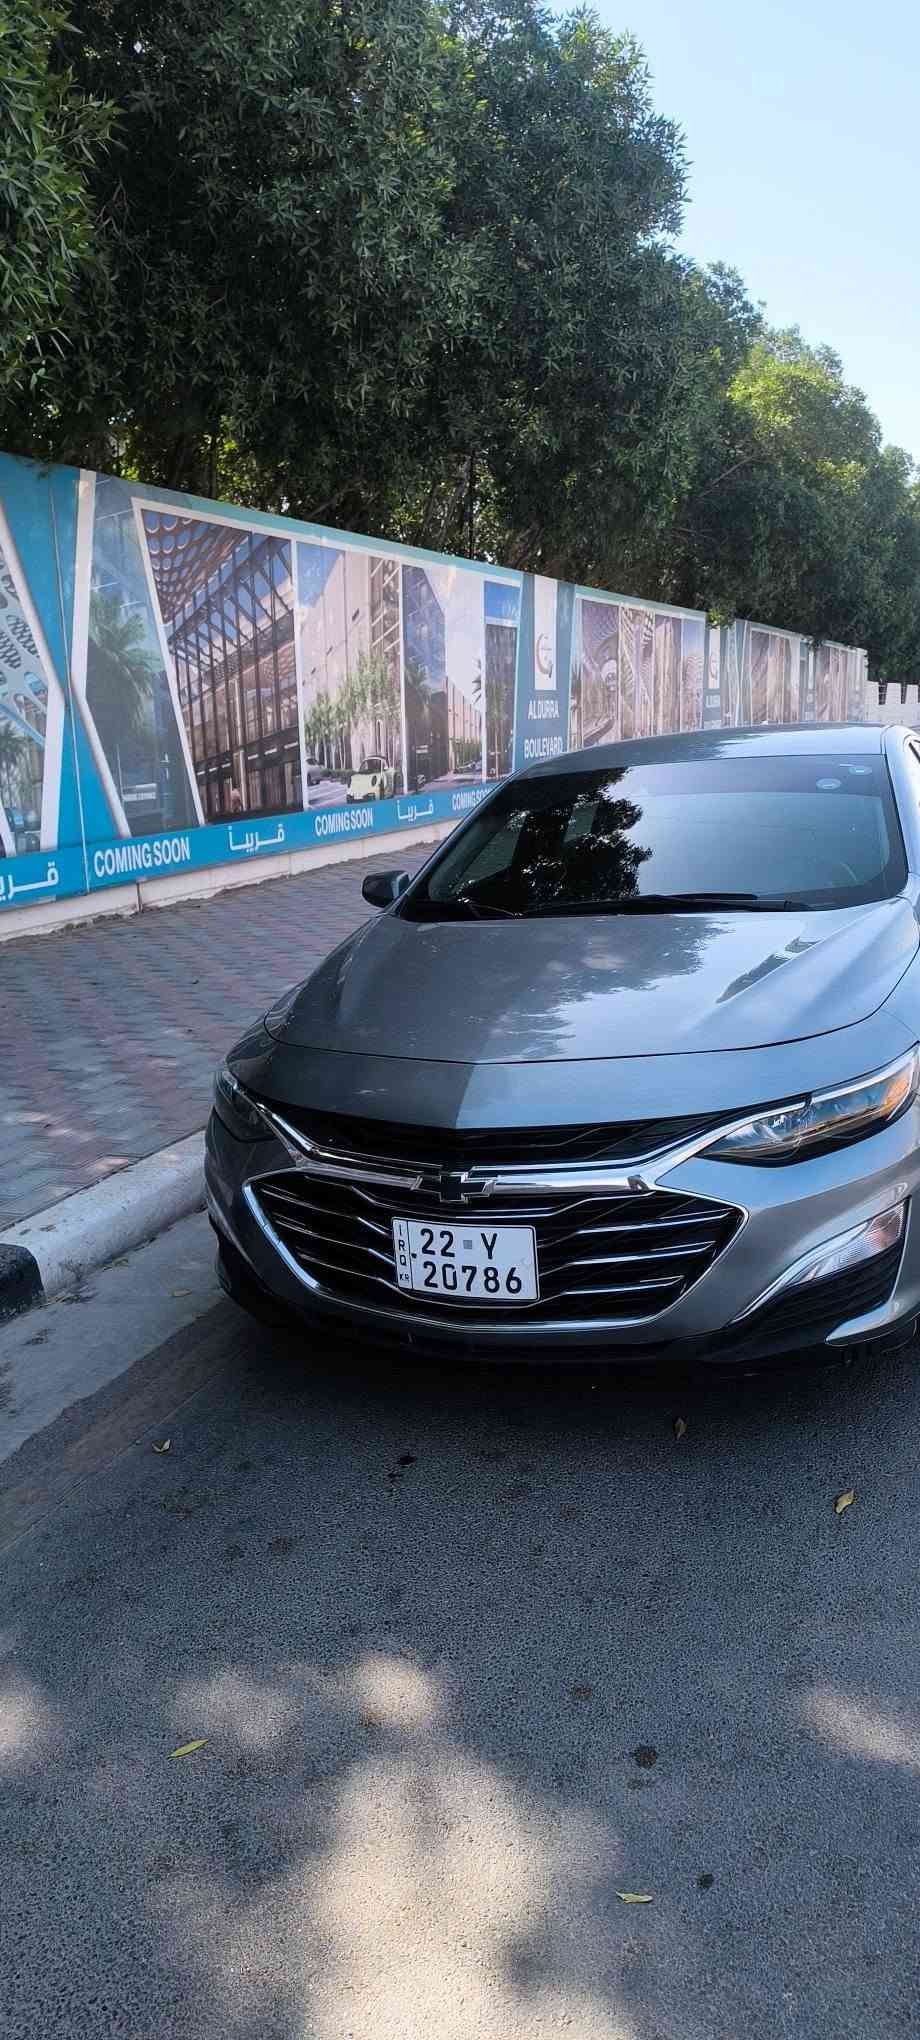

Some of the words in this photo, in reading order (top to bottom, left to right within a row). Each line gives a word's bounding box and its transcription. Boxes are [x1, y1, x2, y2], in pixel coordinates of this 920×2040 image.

[528, 700, 560, 720] ALDURRA
[524, 737, 564, 759] BOULEVARD
[452, 789, 476, 811] COMING
[314, 813, 350, 837] COMING
[350, 807, 374, 829] SOON
[94, 843, 152, 877] COMING
[152, 836, 191, 867] SOON
[420, 1228, 455, 1257] 22
[480, 1232, 498, 1260] Y
[423, 1261, 522, 1294] 20786
